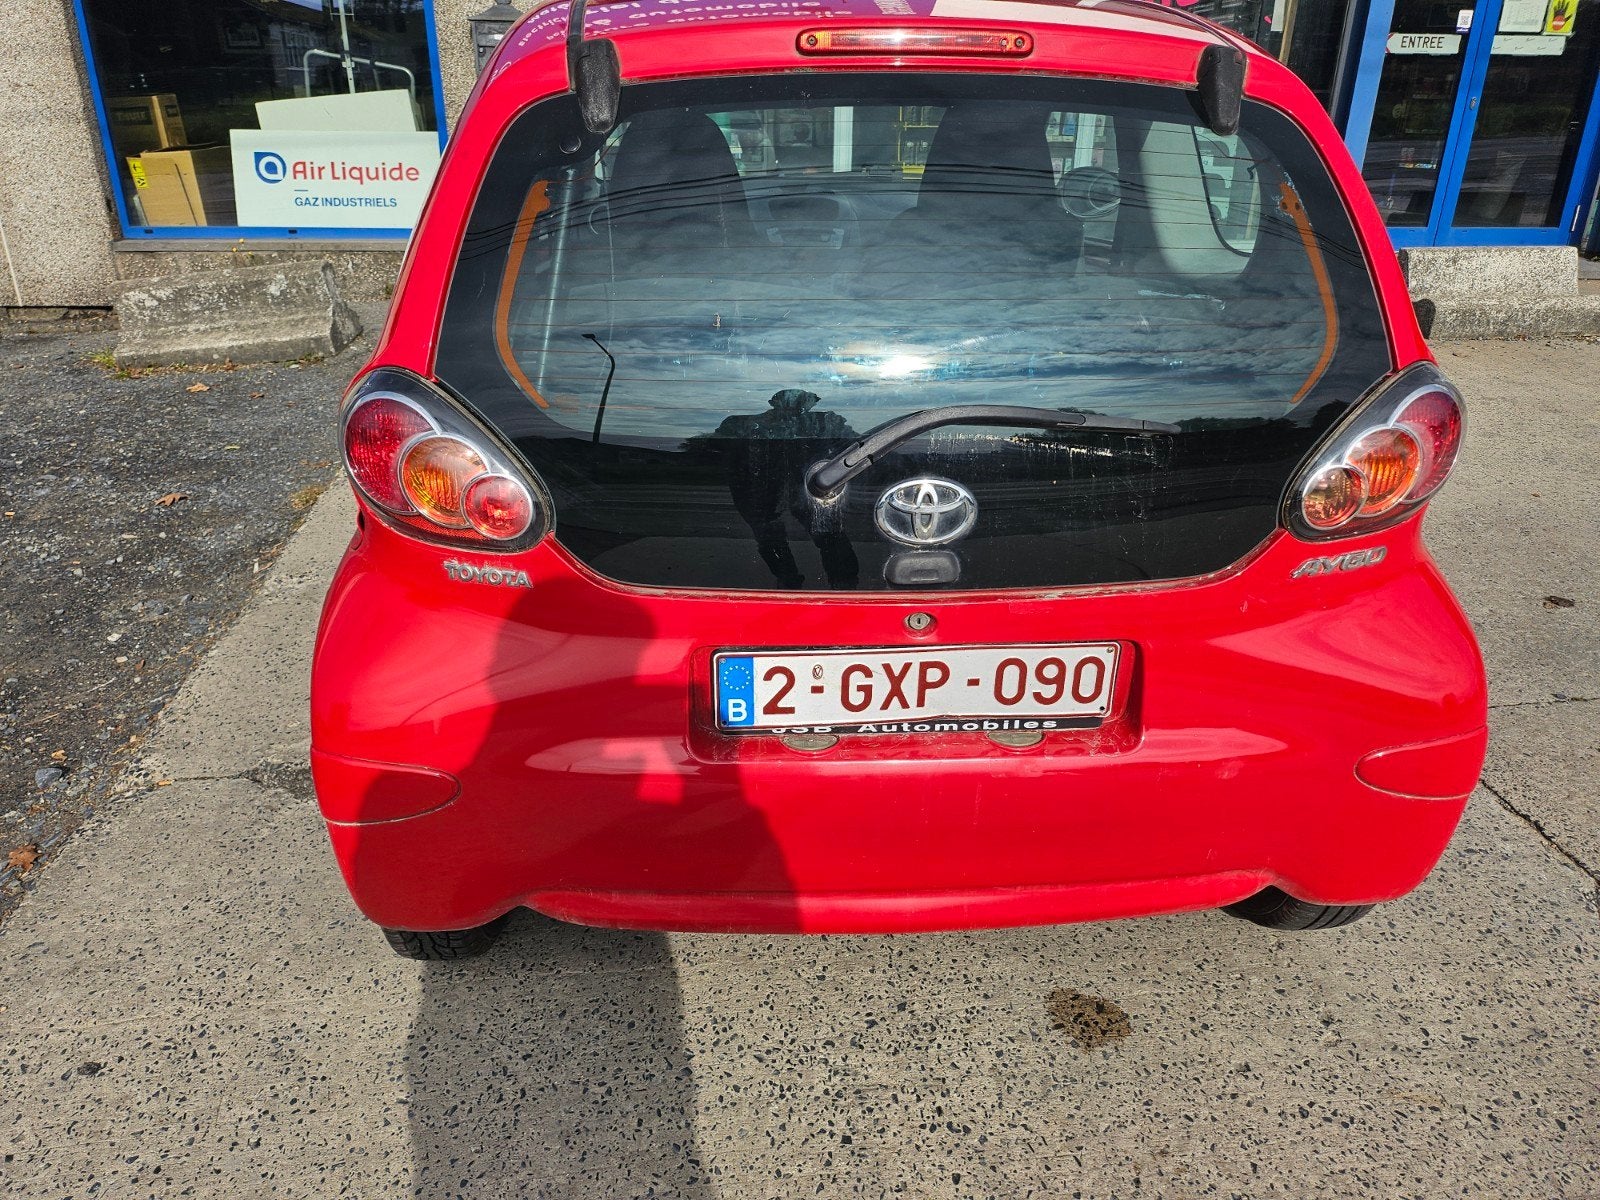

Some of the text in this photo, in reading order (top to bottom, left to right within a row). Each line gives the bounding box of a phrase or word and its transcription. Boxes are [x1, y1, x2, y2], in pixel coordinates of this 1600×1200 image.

[1400, 35, 1445, 49] ENTREE
[292, 161, 419, 185] Air Liquide
[294, 197, 397, 208] GAZ INDUSTRIELS
[443, 559, 534, 588] TOYOTA
[1290, 546, 1387, 579] AYGO
[727, 699, 748, 722] B
[857, 719, 1057, 733] Automobiles
